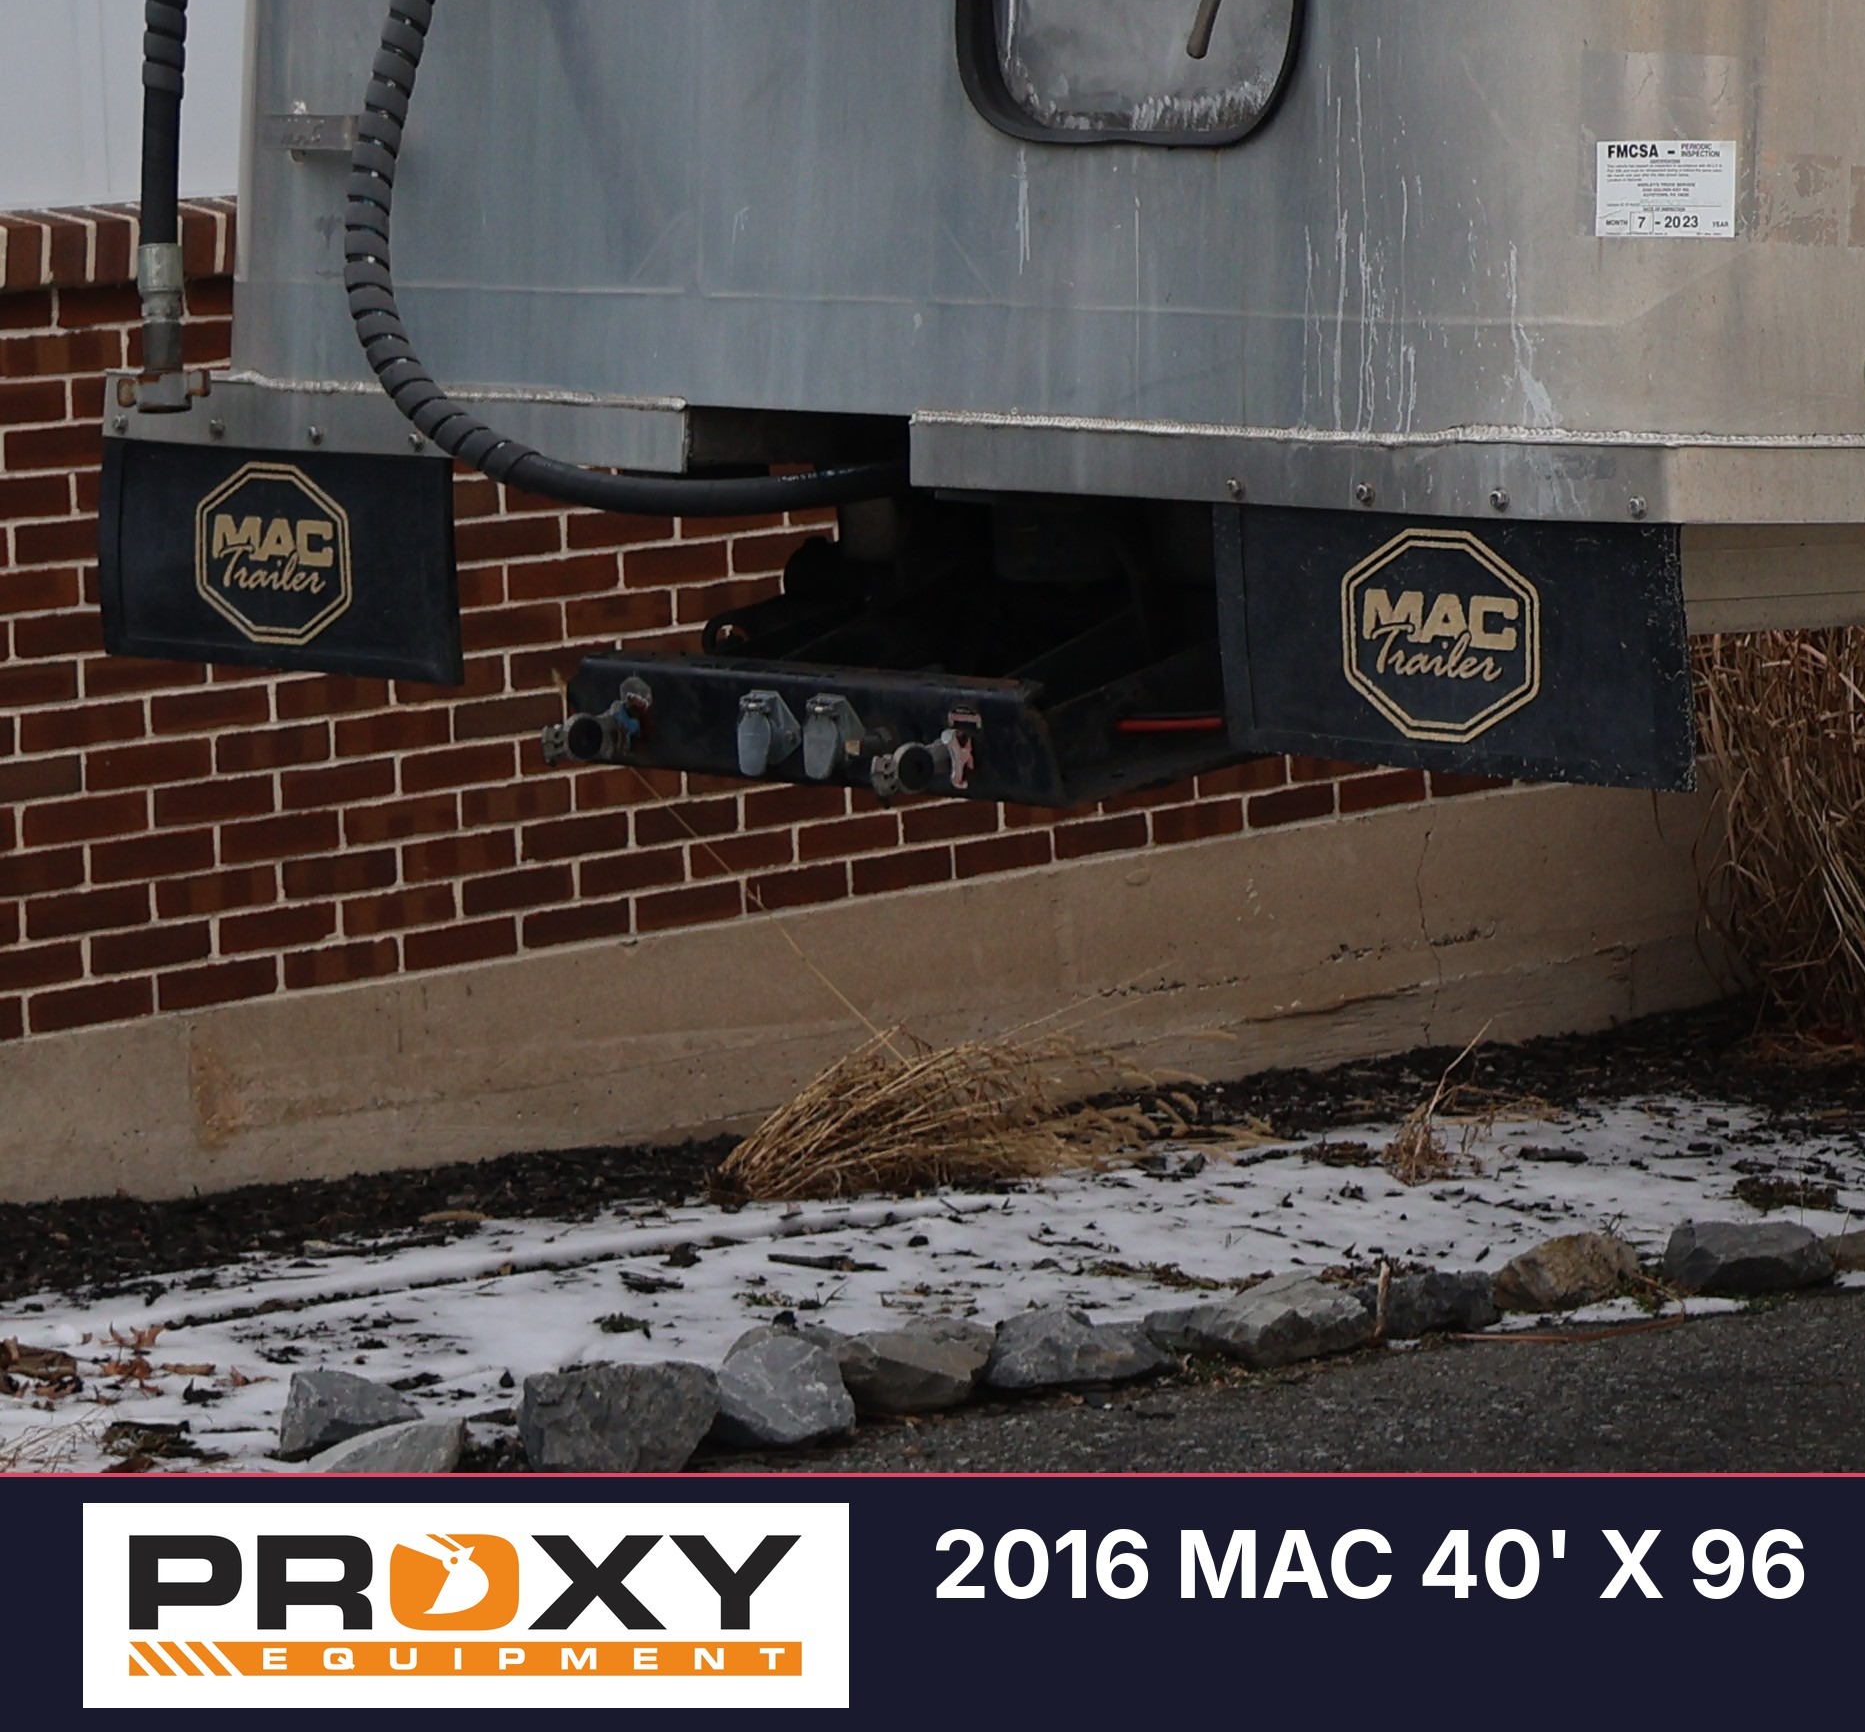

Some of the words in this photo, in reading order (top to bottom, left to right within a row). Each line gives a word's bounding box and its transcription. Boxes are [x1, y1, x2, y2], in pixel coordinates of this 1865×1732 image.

[1607, 144, 1659, 159] FMCSA
[1681, 150, 1720, 158] INSPECTION
[1637, 216, 1646, 228] 7
[1664, 215, 1698, 228] 2023
[212, 514, 333, 567] MAC
[218, 544, 326, 594] Trailer
[1363, 587, 1519, 651] MAC
[1370, 622, 1502, 683] Trailer
